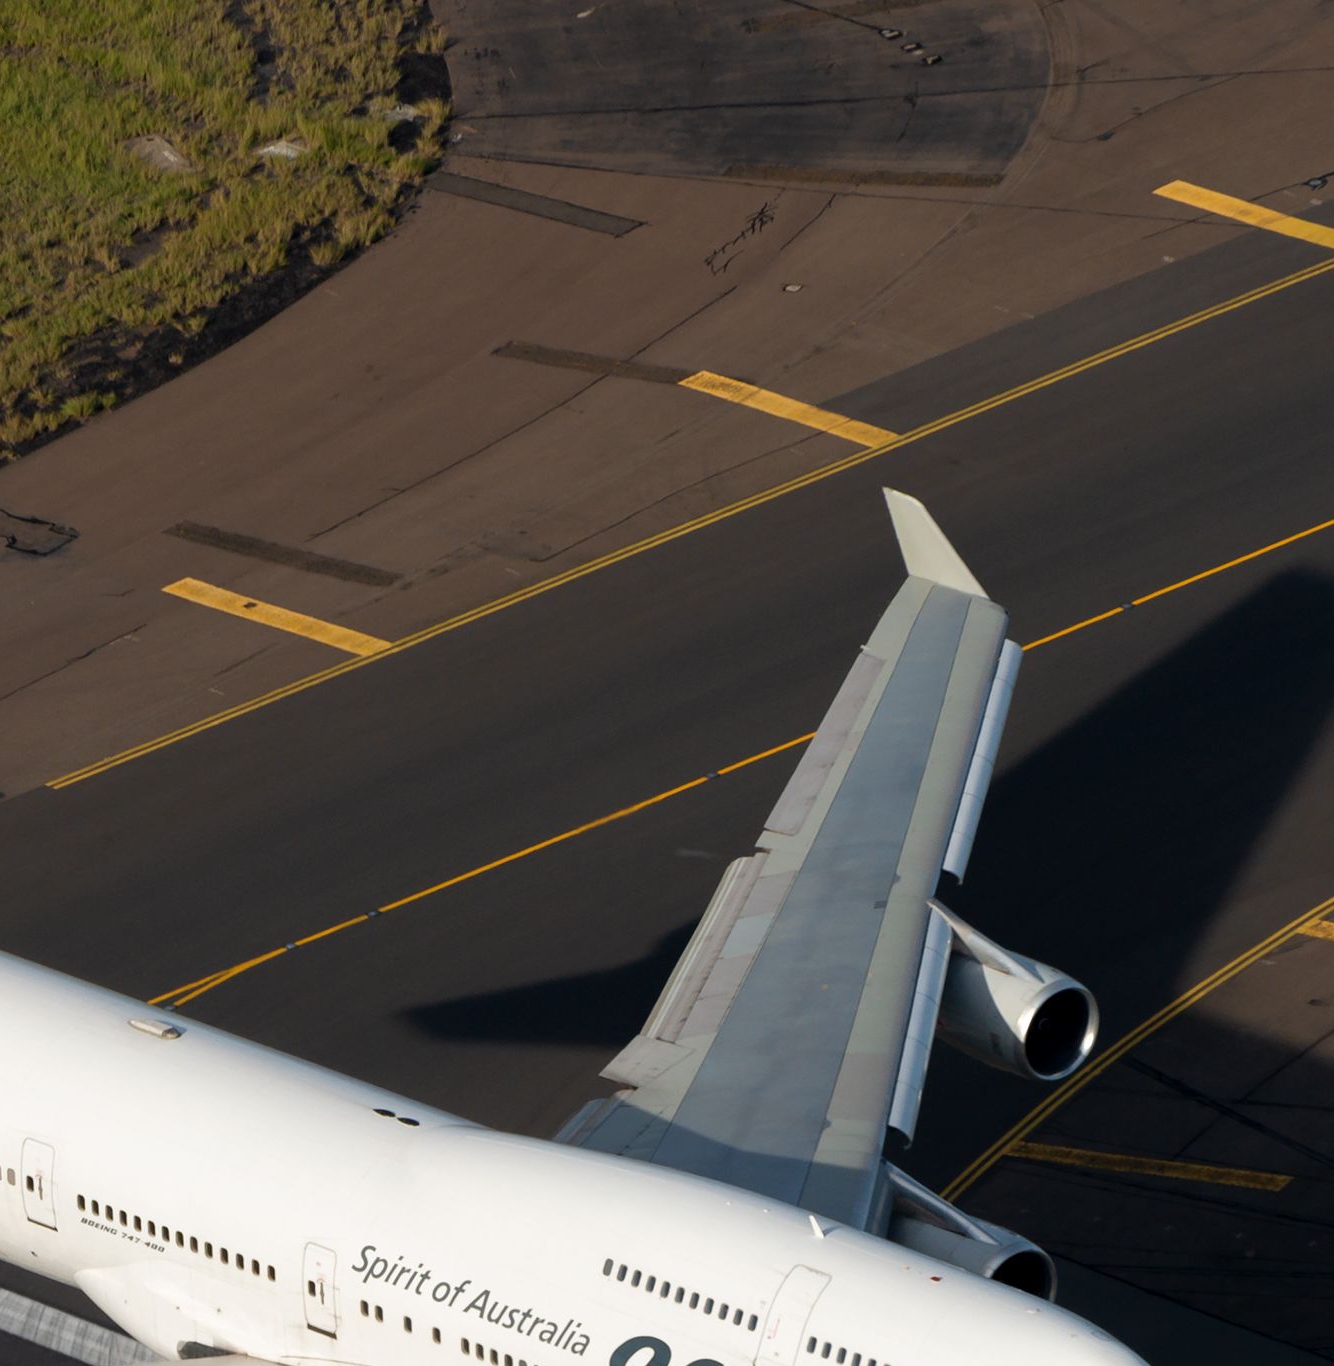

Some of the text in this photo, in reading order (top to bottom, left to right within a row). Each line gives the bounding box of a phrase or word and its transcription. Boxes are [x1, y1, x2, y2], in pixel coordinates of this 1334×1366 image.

[80, 1217, 118, 1235] BOEING
[351, 1245, 591, 1357] Spirit of Australia
